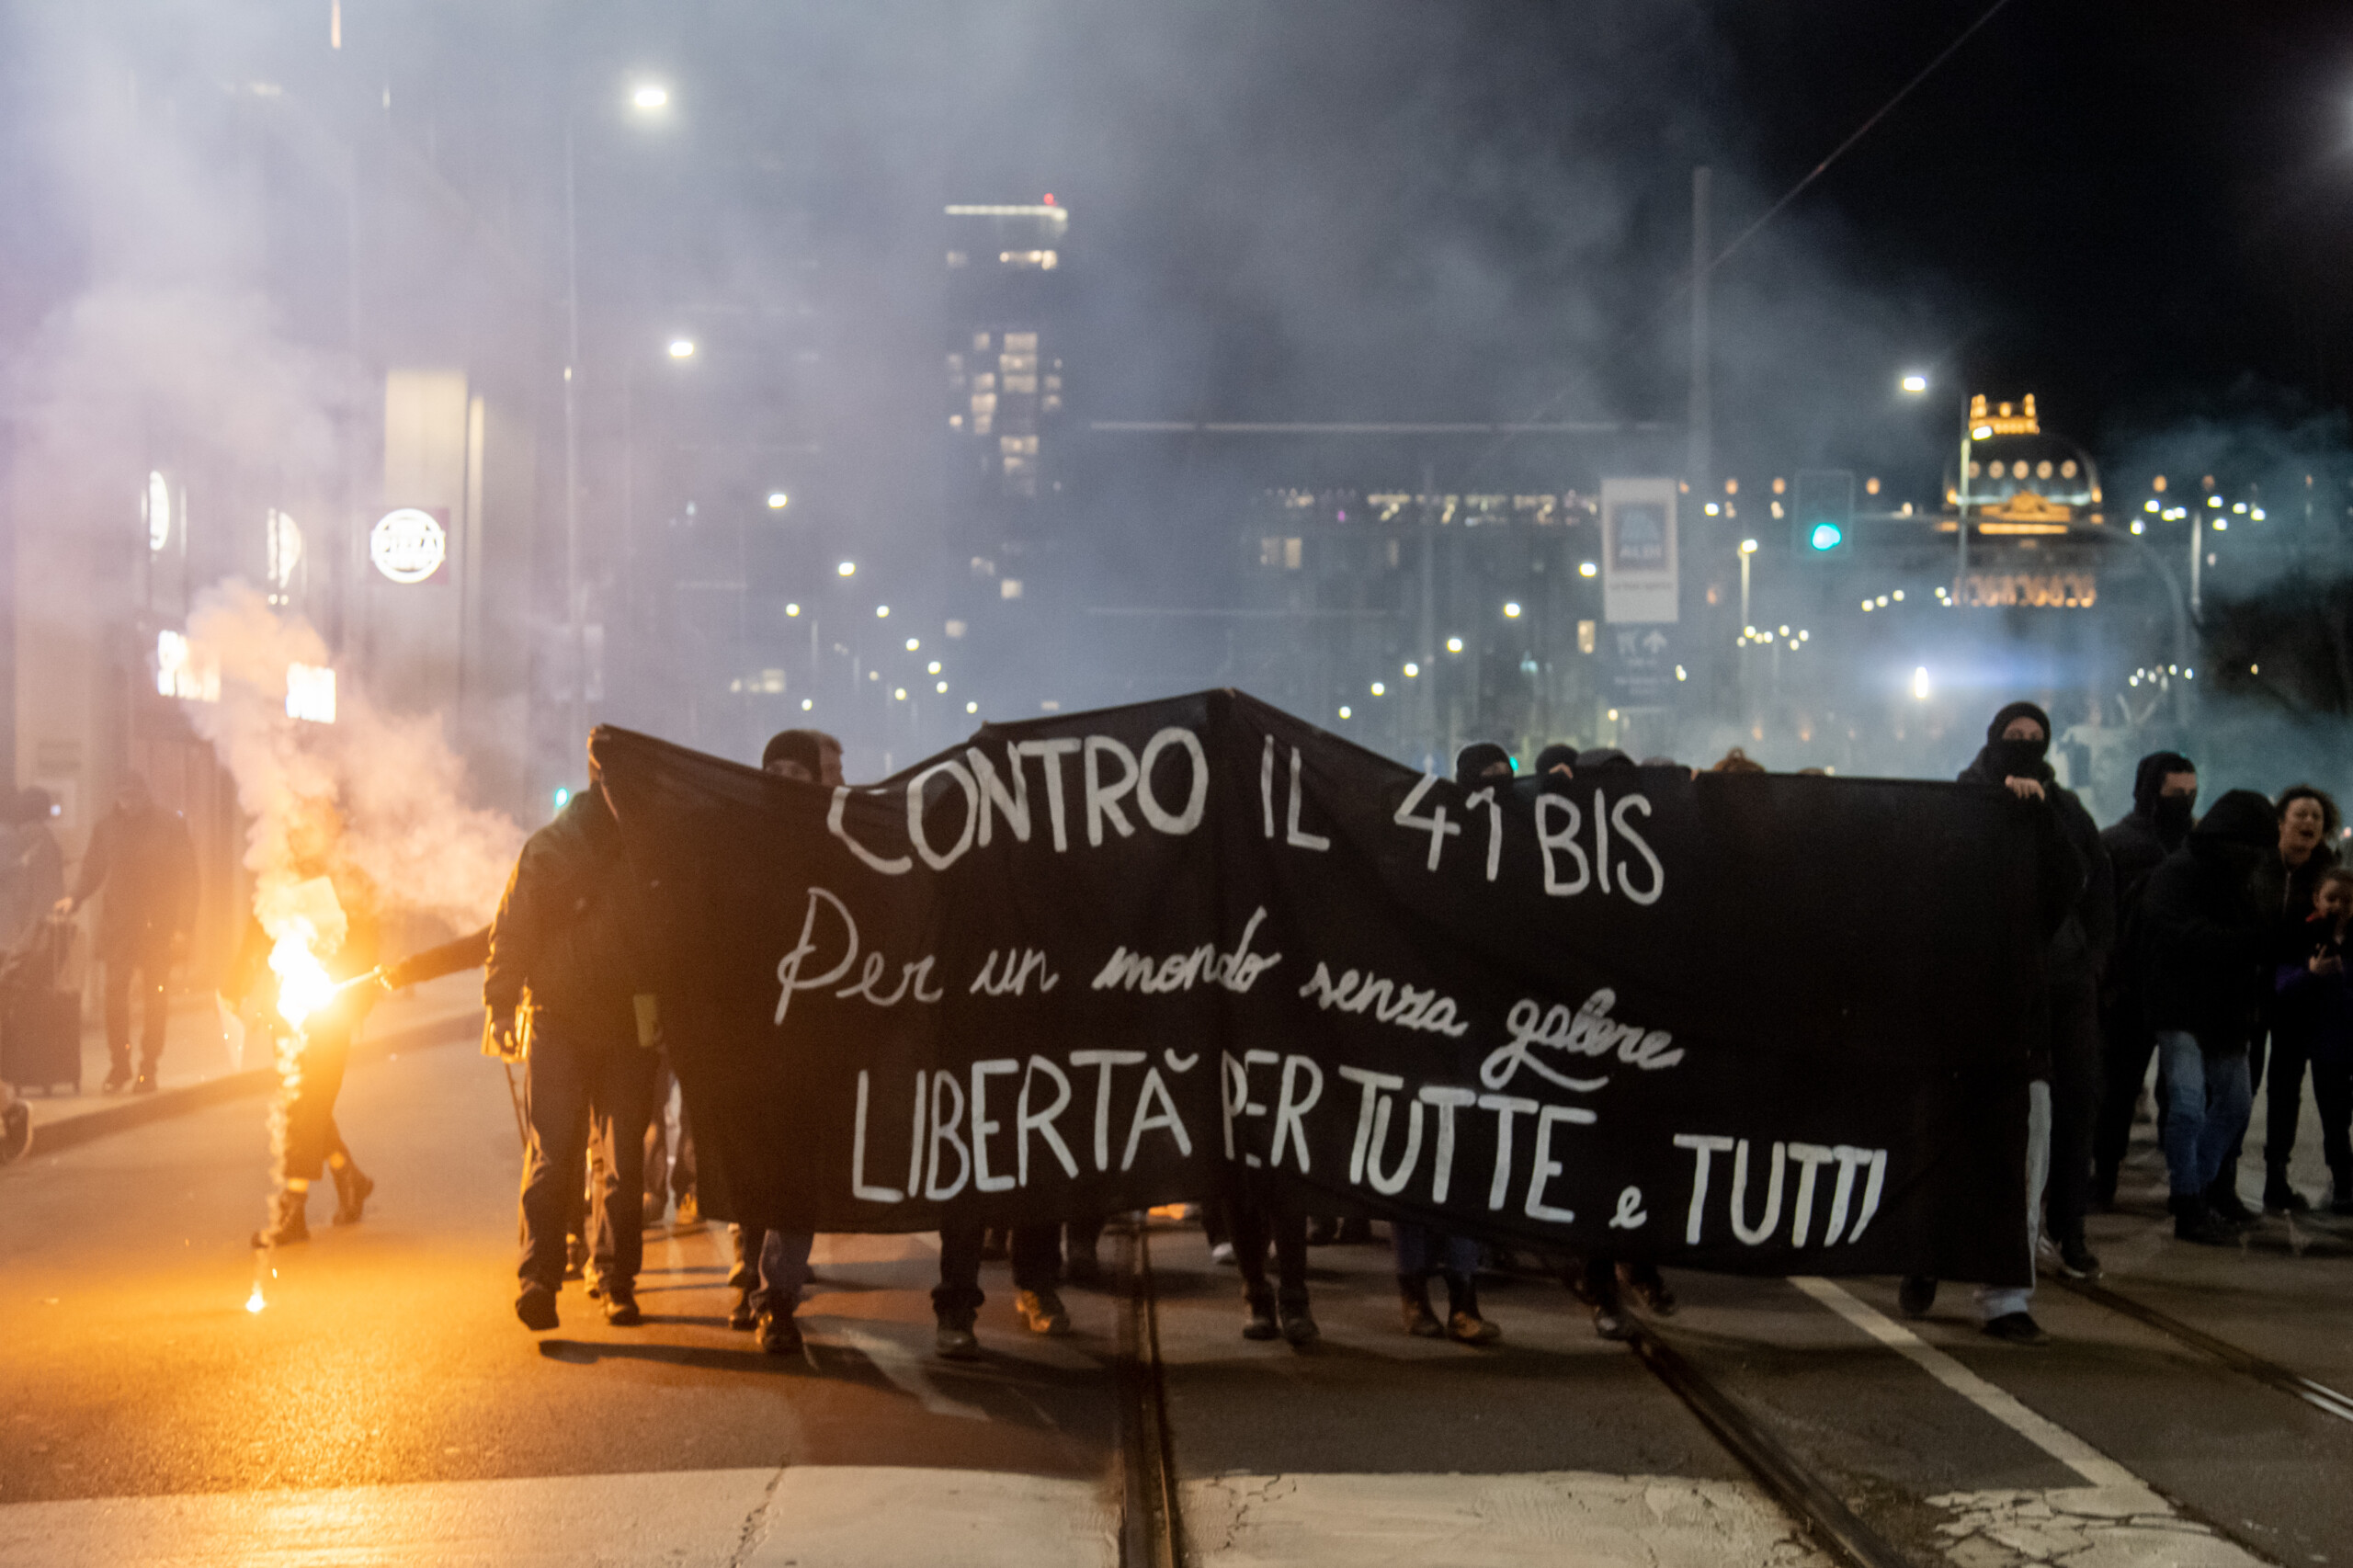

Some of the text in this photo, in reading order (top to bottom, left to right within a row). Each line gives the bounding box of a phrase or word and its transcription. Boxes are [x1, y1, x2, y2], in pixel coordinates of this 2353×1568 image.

[827, 728, 1665, 904] CONTRO IL 41 BIS
[774, 887, 1686, 1092] Per un mondo senza galere
[1221, 1049, 1323, 1173] PER
[1339, 1065, 1597, 1221] TUTTE
[1609, 1187, 1648, 1229] e
[1674, 1134, 1889, 1248] TUTTI
